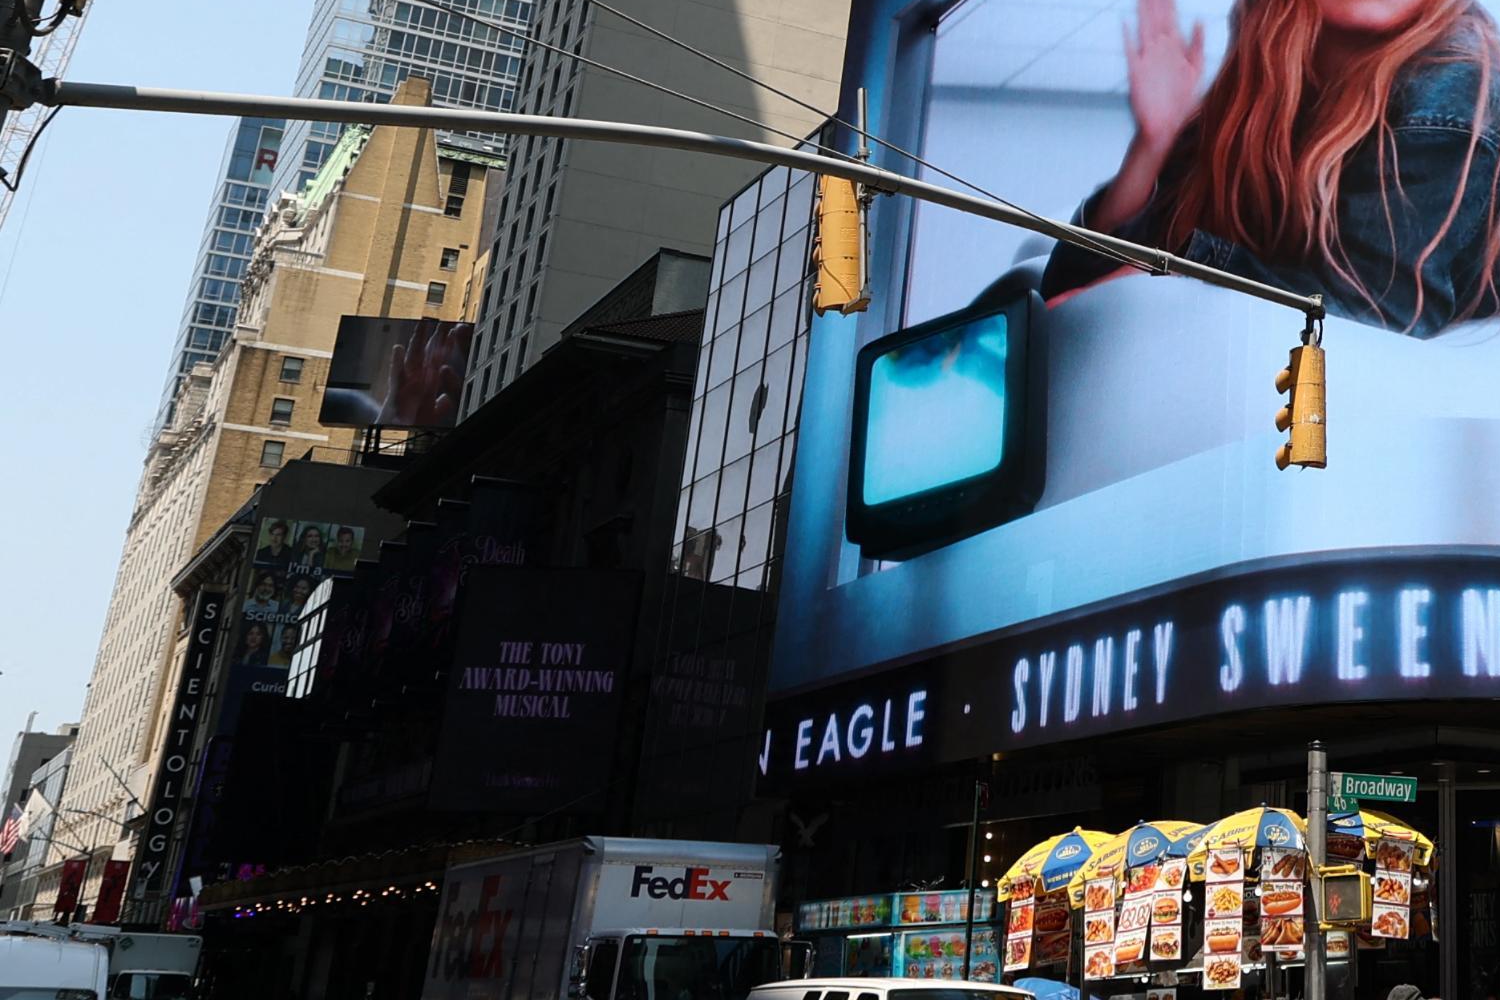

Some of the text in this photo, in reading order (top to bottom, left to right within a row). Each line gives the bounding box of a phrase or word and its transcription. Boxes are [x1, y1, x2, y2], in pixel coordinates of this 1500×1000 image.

[288, 562, 310, 573] I'm
[500, 641, 586, 665] THE TONY
[459, 667, 614, 693] AWARD-WINNING
[493, 694, 570, 718] MUSICAL
[795, 690, 927, 769] EAGLE
[1011, 621, 1174, 734] SYDNEY
[141, 603, 218, 879] SCIENTOLOGY
[1346, 776, 1412, 801] Broadway
[630, 865, 732, 901] FedEx
